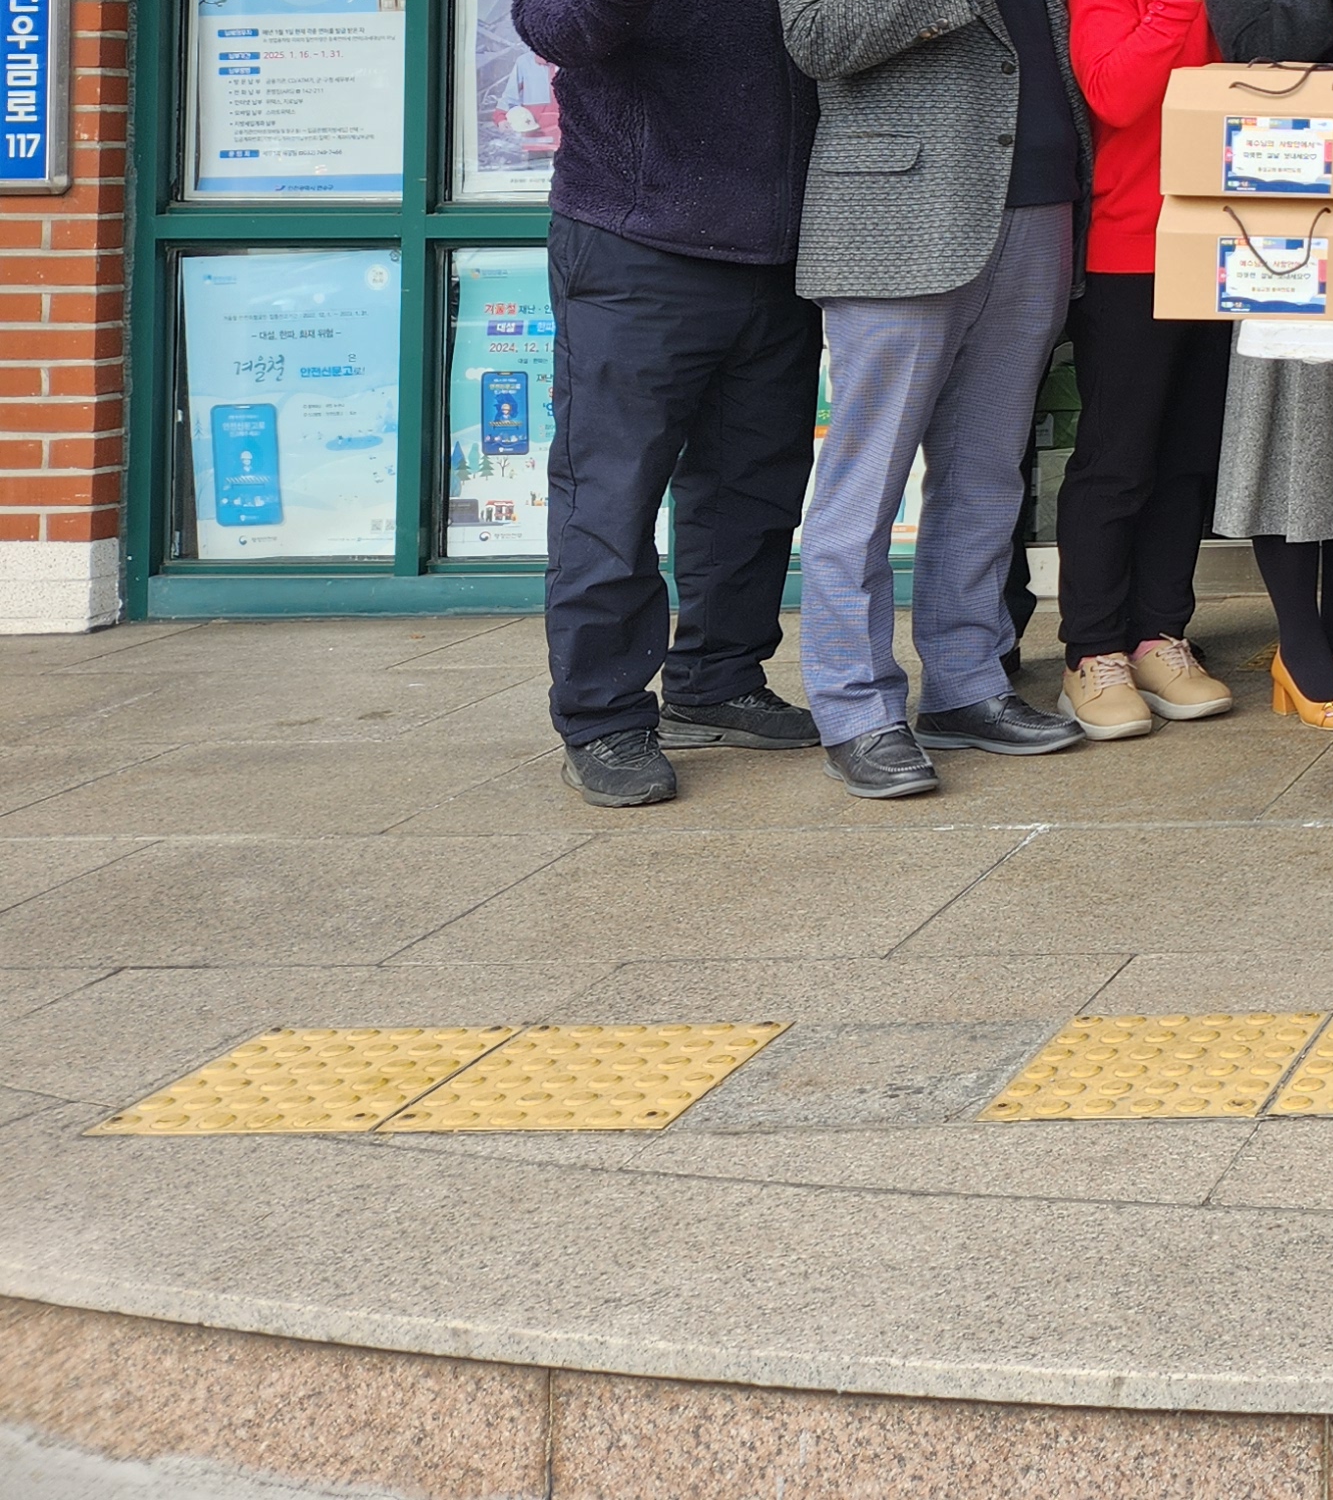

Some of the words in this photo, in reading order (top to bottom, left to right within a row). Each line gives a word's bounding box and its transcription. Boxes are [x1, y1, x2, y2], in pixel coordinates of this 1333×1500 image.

[330, 50, 344, 58] 31.
[6, 134, 40, 157] 117
[484, 303, 517, 315] 겨울철
[518, 304, 536, 314] 재난
[259, 331, 277, 340] 대설,
[280, 330, 297, 340] 한파,
[300, 329, 315, 339] 화재
[318, 328, 333, 338] 위험
[496, 323, 514, 333] 대설
[489, 343, 518, 352] 2024.
[524, 343, 539, 352] 12.
[233, 354, 285, 384] 겨울철
[300, 366, 365, 378] 안전신문고로!
